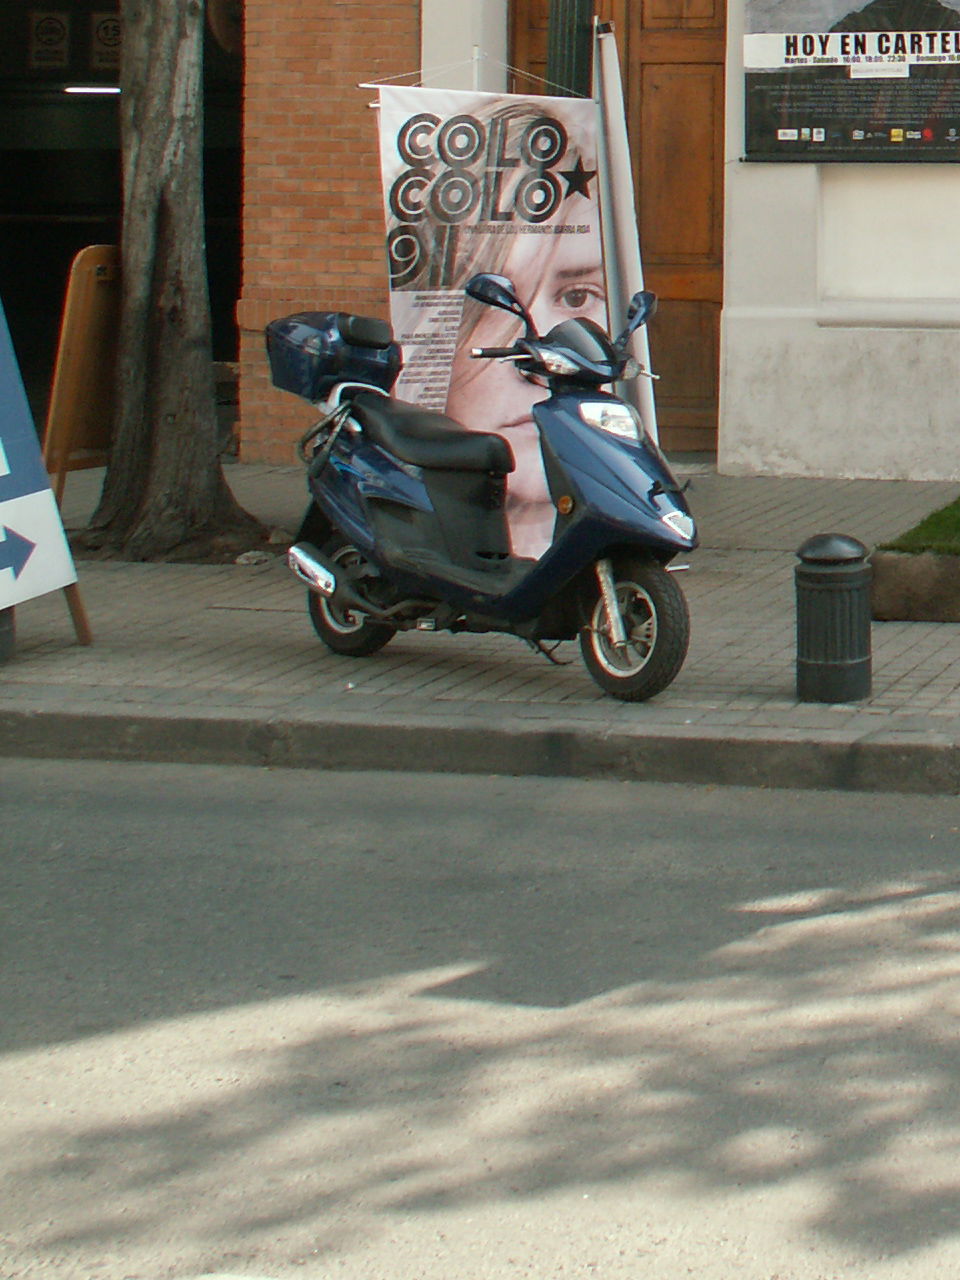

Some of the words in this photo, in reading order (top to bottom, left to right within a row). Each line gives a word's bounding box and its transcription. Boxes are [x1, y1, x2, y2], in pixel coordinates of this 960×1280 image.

[785, 34, 831, 57] HOY
[840, 33, 867, 56] EN
[396, 112, 568, 171] COLO
[389, 167, 562, 223] COLO
